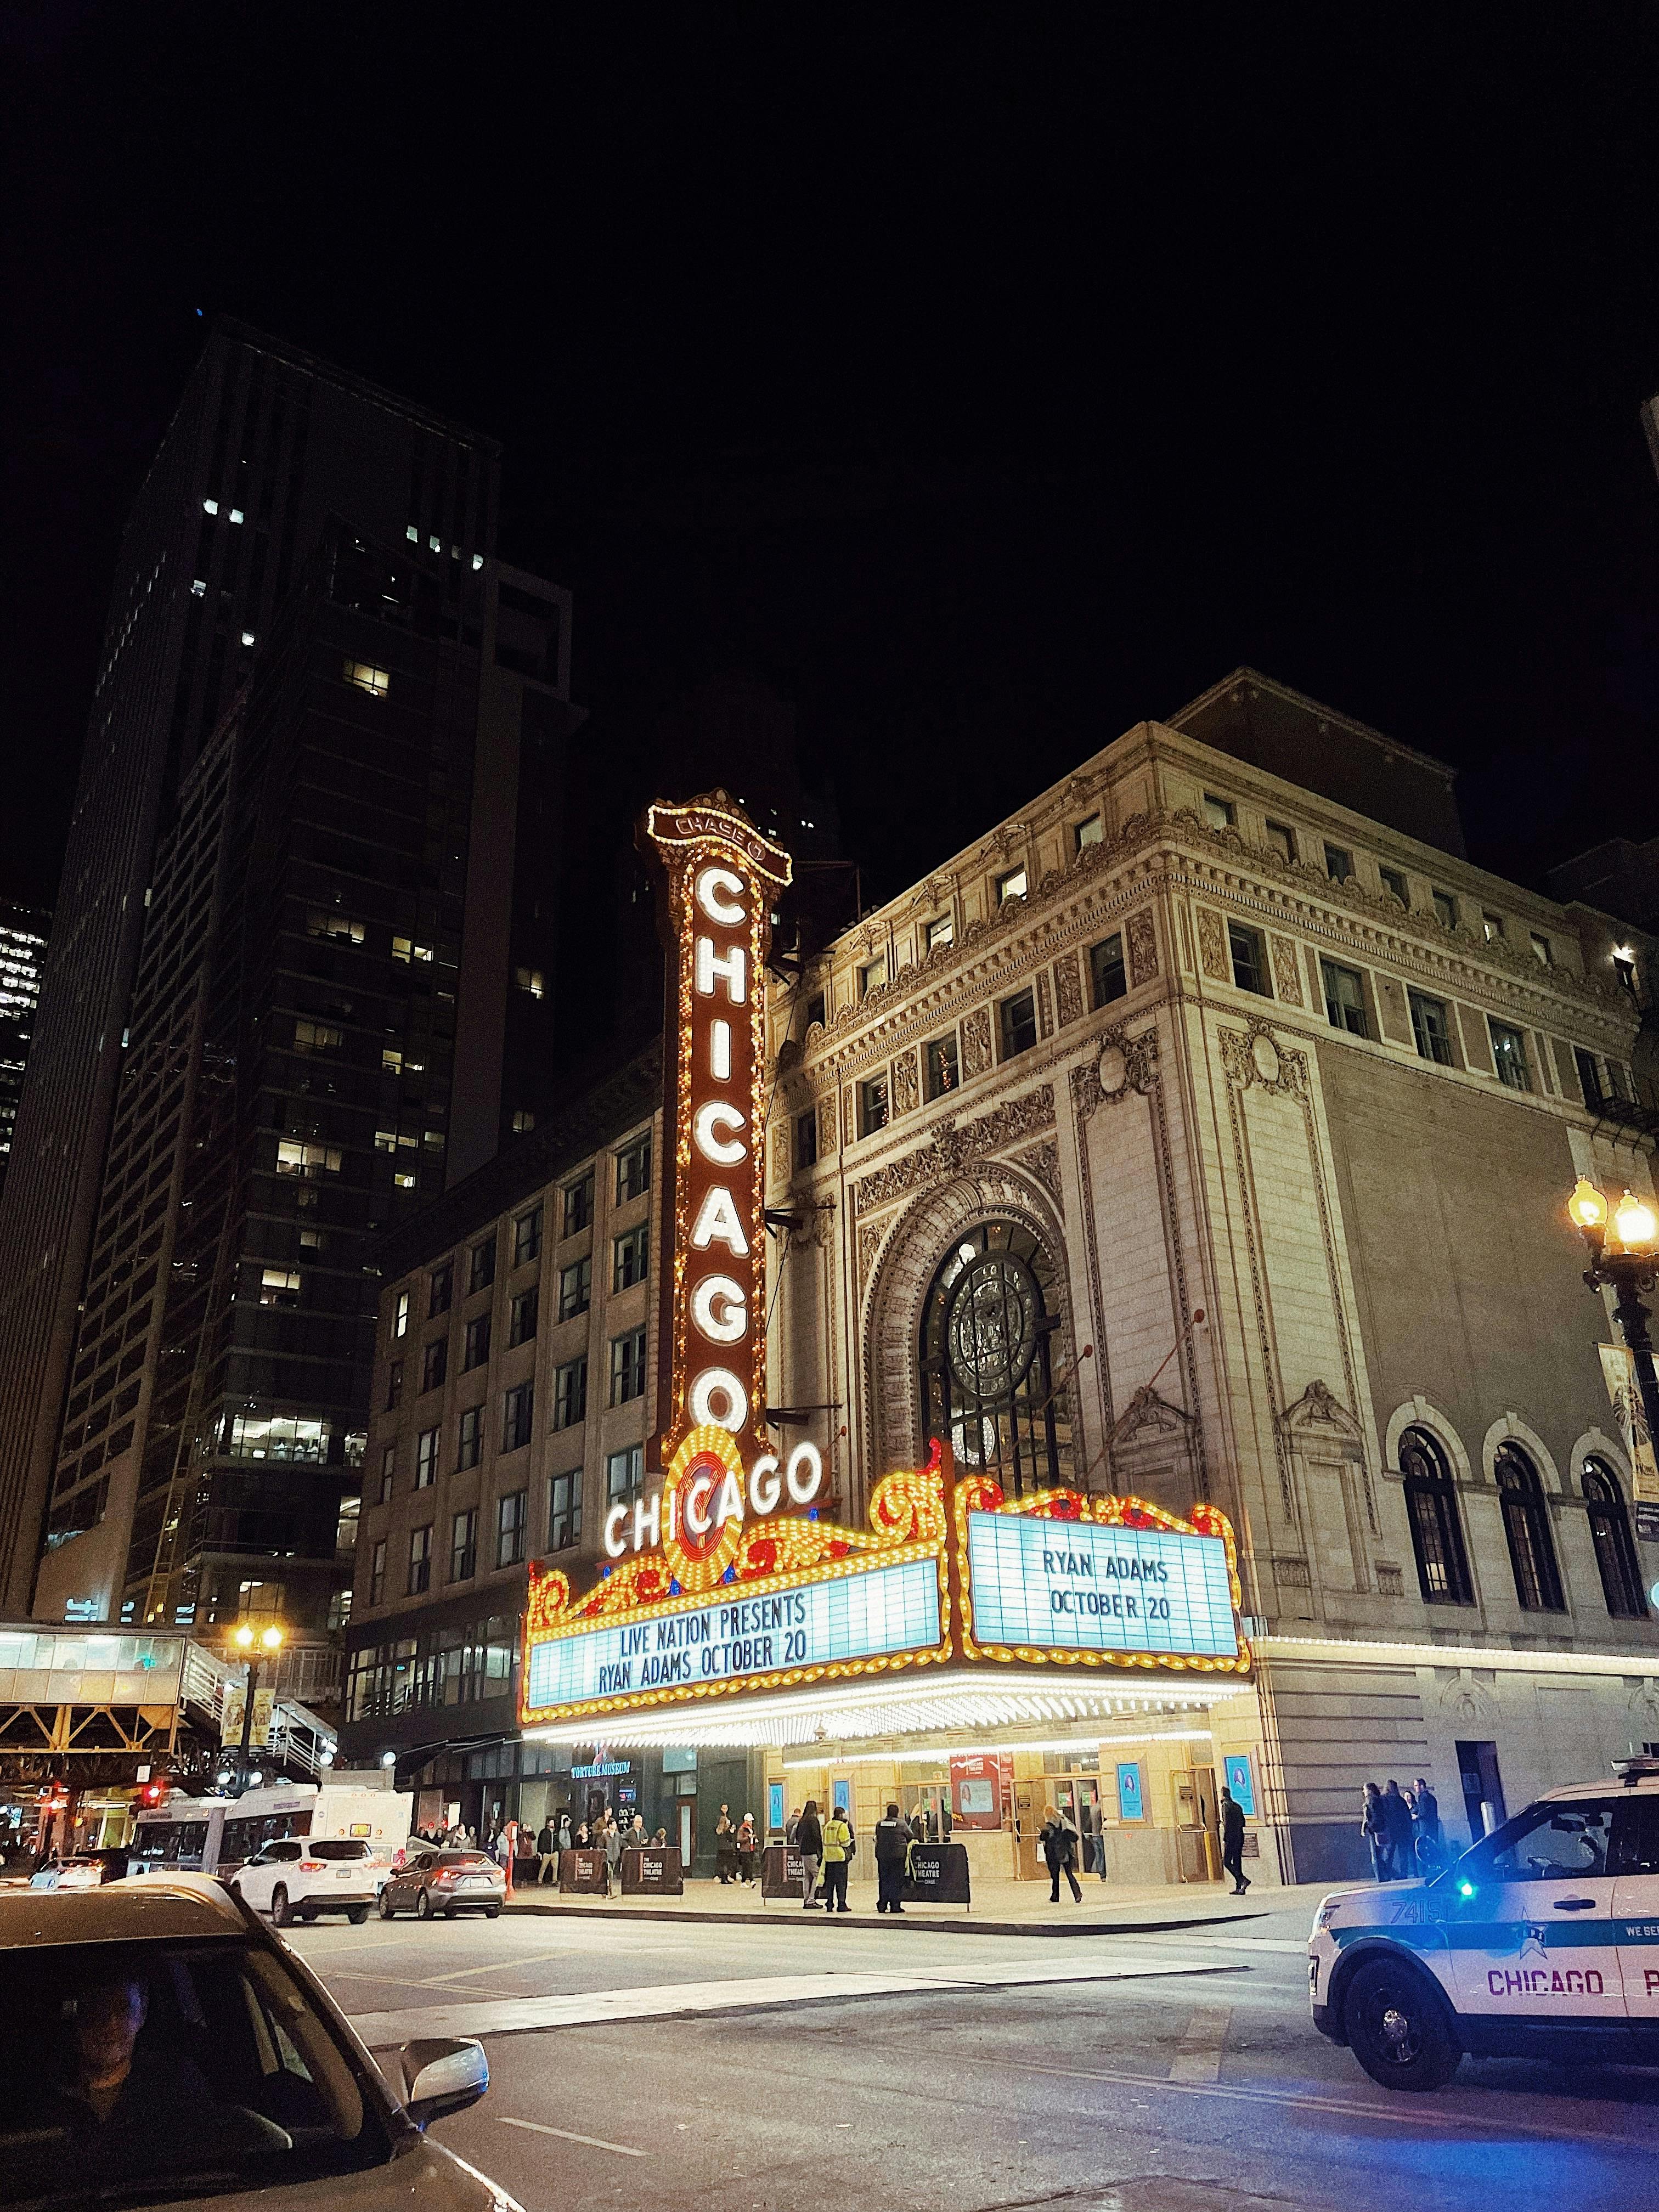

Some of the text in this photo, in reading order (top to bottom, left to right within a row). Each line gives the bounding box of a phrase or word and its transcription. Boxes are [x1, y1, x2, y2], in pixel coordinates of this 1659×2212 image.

[676, 817, 746, 846] CHASE
[689, 867, 749, 1434] CHICAGO
[605, 1442, 822, 1559] CHICAGO
[1042, 1550, 1169, 1583] RYAN ADAMS
[1050, 1590, 1170, 1620] OCTOBER 20
[620, 1592, 806, 1657] LIVE NATION PRESENTS
[599, 1629, 806, 1694] RYAN ADAMS OCTOBER 20
[571, 1761, 630, 1779] TORTURE MUSEUM
[914, 1861, 940, 1869] CHICAGO
[1391, 1900, 1442, 1924] 7415
[1626, 1926, 1643, 1937] WE
[1488, 1970, 1604, 1996] CHICAGO
